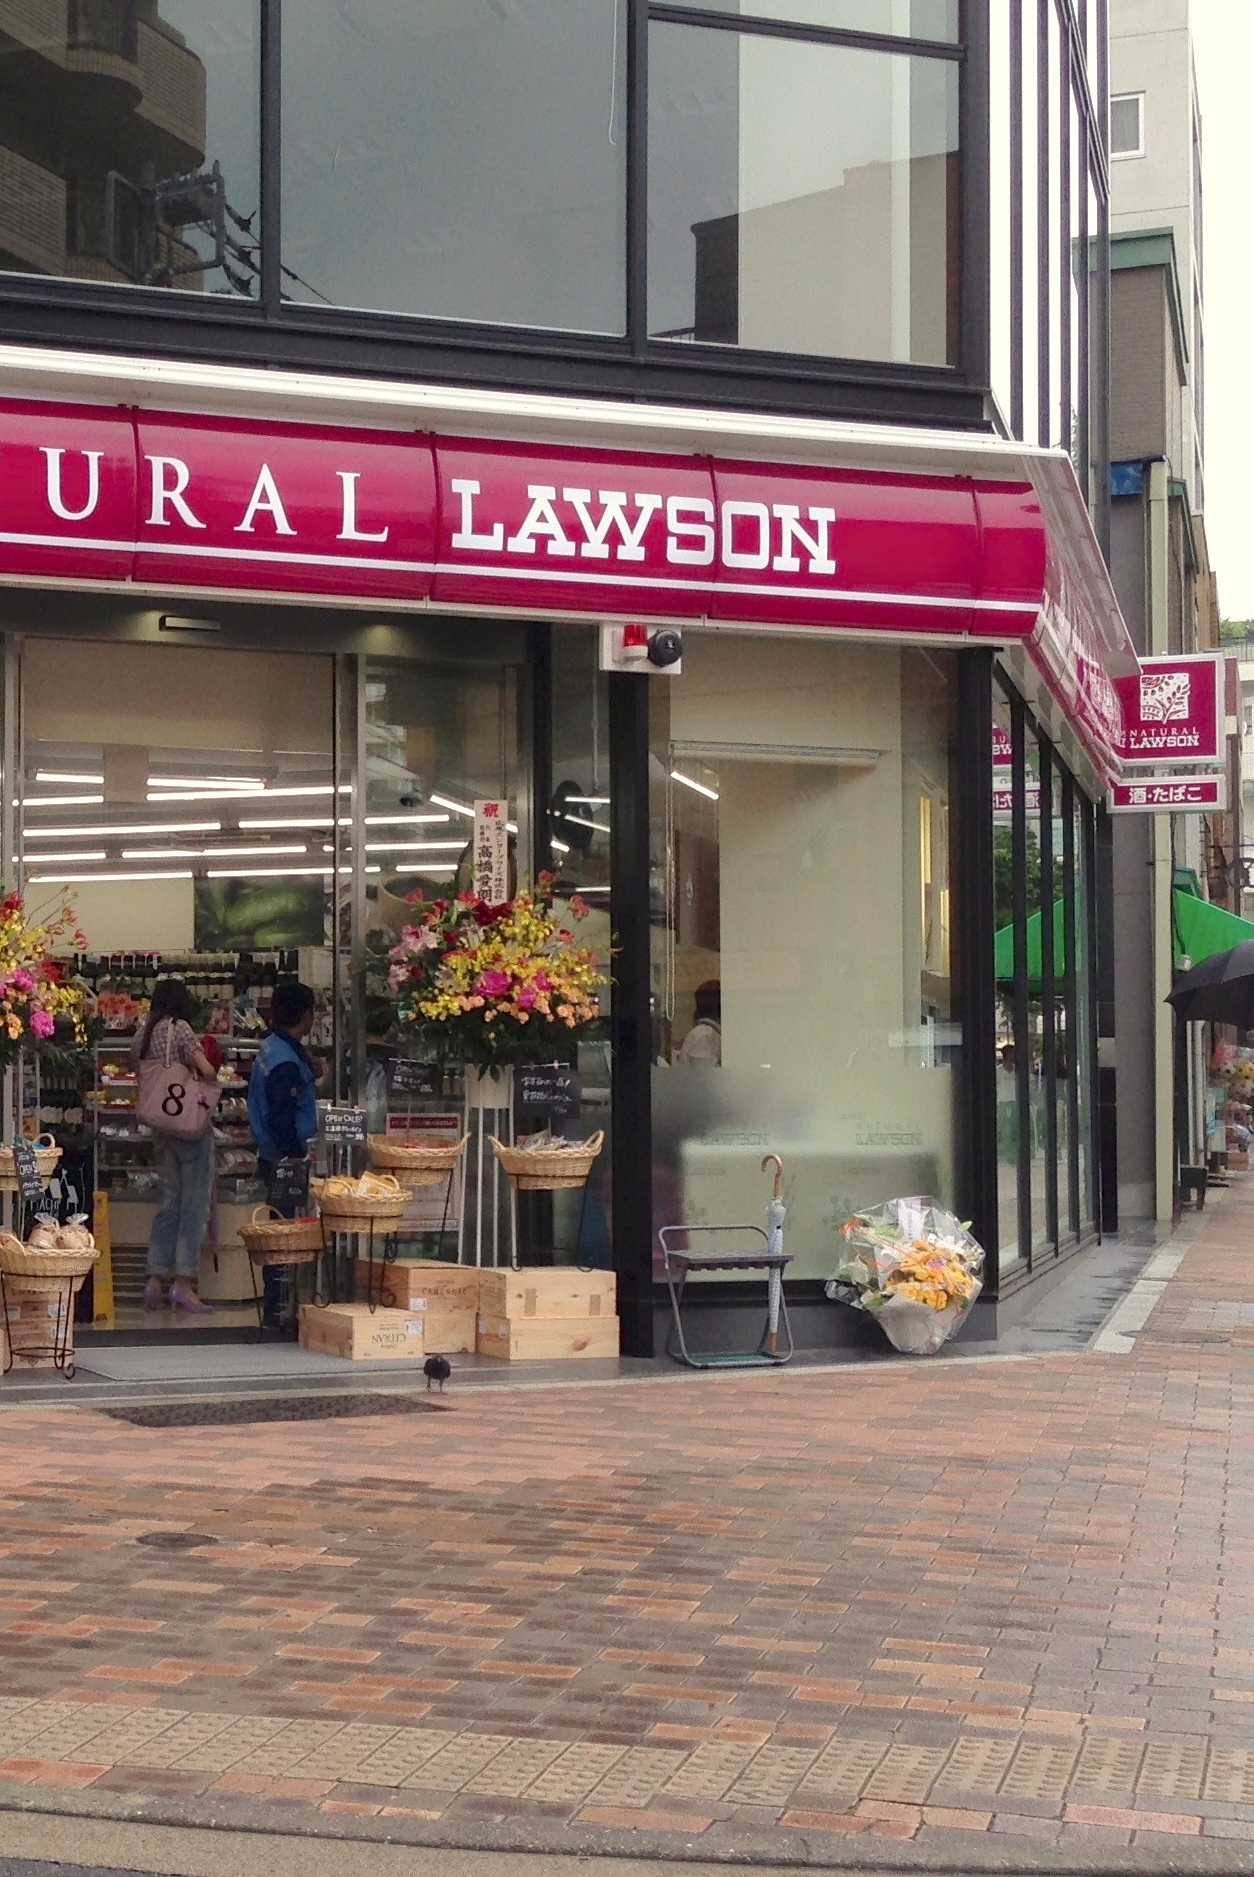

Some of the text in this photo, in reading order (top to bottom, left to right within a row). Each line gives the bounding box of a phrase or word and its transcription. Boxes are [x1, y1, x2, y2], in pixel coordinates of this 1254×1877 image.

[451, 479, 836, 574] LAWSON
[1130, 727, 1200, 737] NATURAL
[1130, 735, 1200, 749] LAWSON
[1129, 785, 1202, 804] 酒・たばこ
[482, 803, 499, 818] 祝
[162, 1083, 185, 1116] 8
